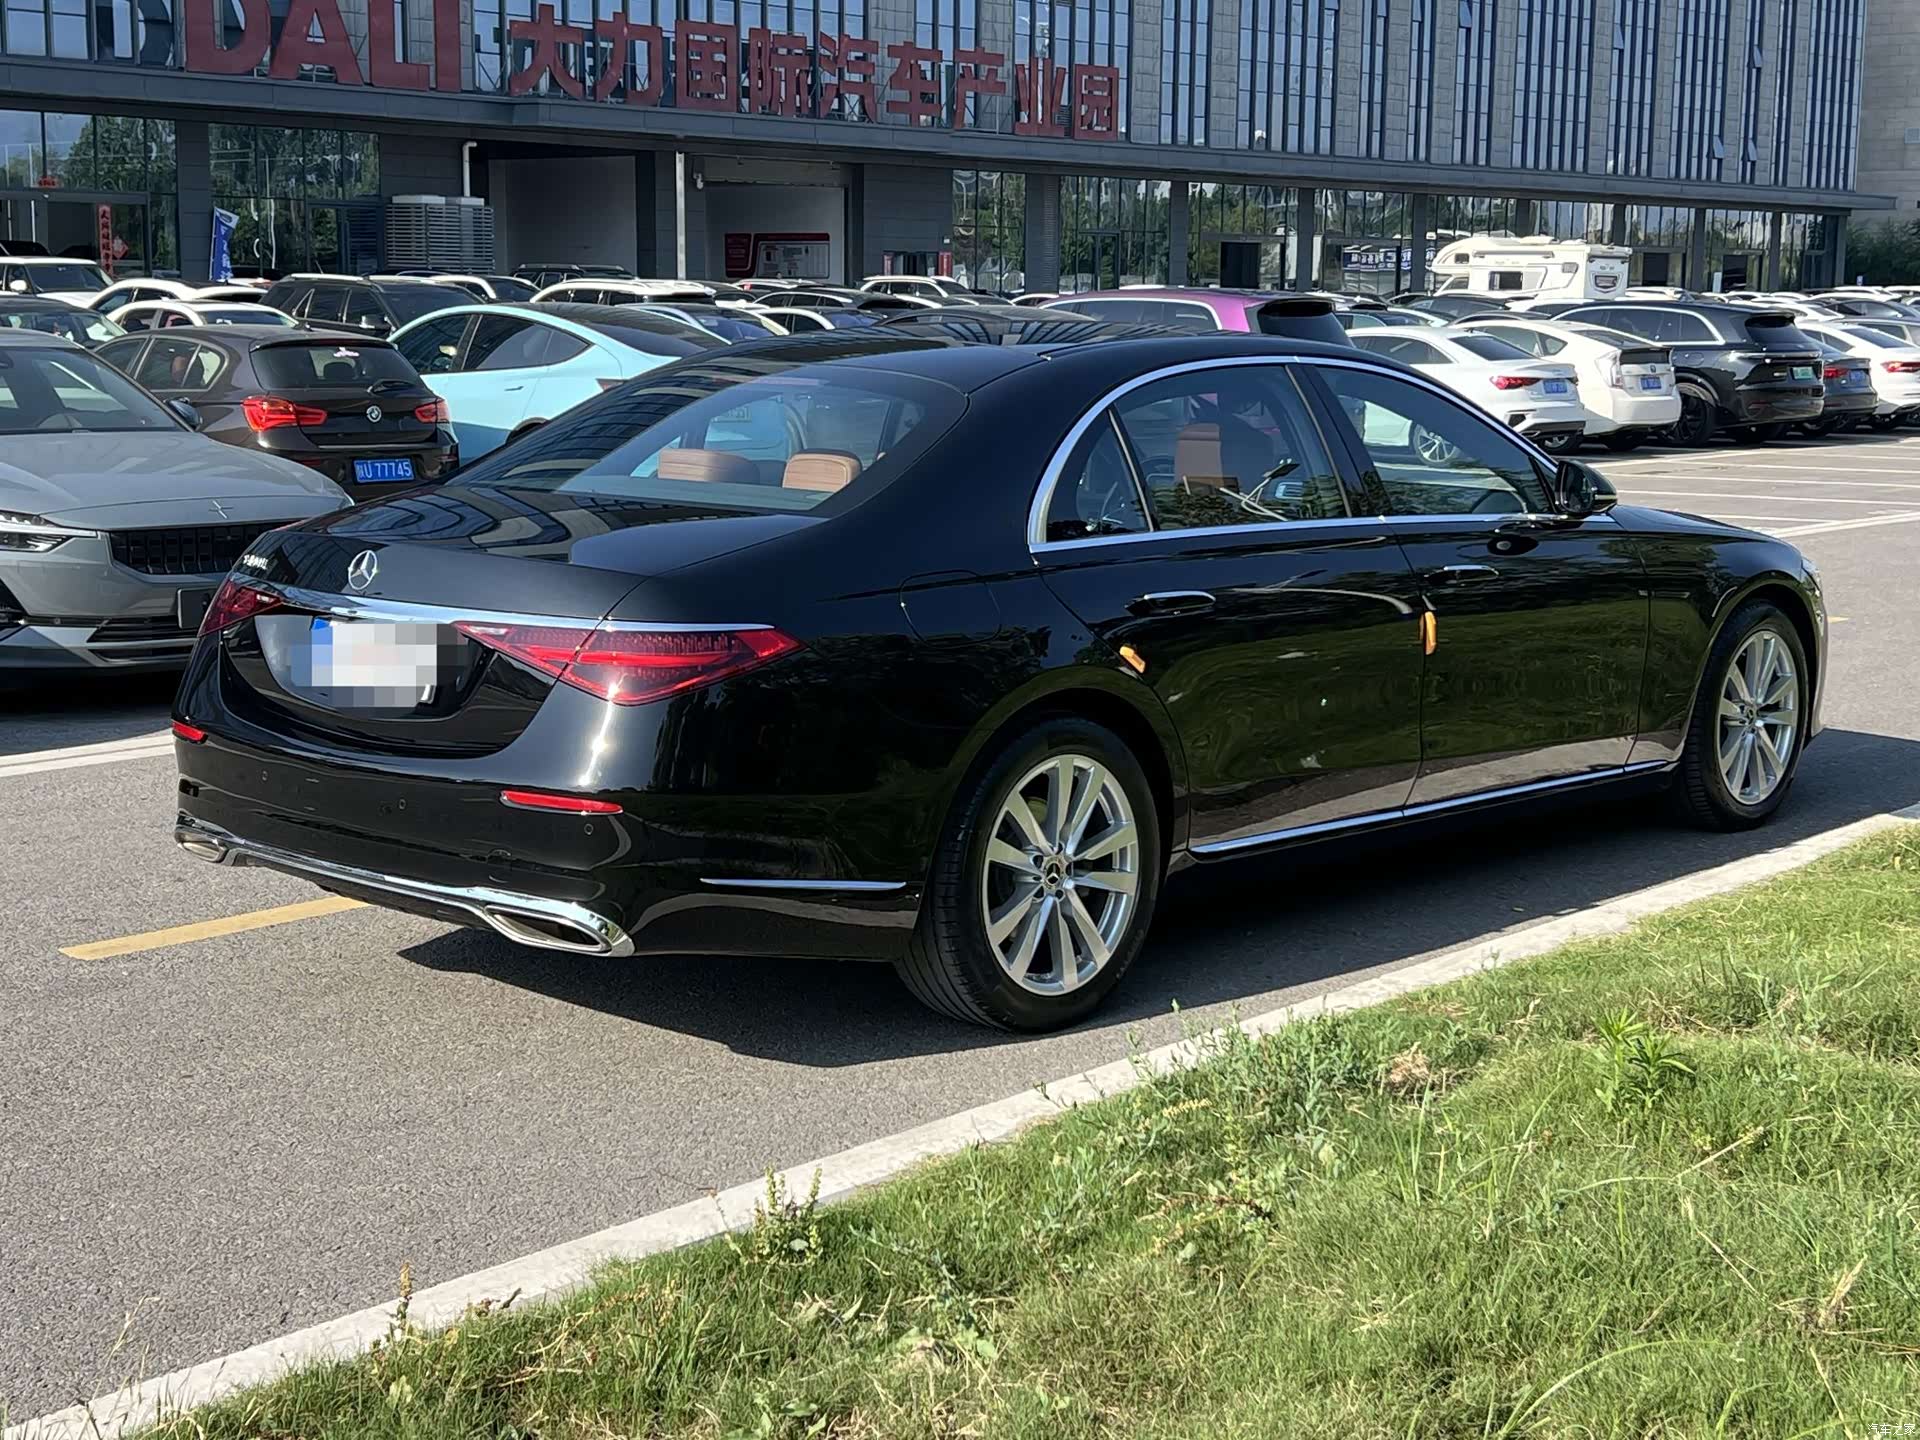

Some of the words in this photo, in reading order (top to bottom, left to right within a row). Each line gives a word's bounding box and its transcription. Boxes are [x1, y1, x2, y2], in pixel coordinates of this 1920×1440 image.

[185, 0, 462, 93] DALI
[509, 4, 1119, 140] 大力国际汽车产业园
